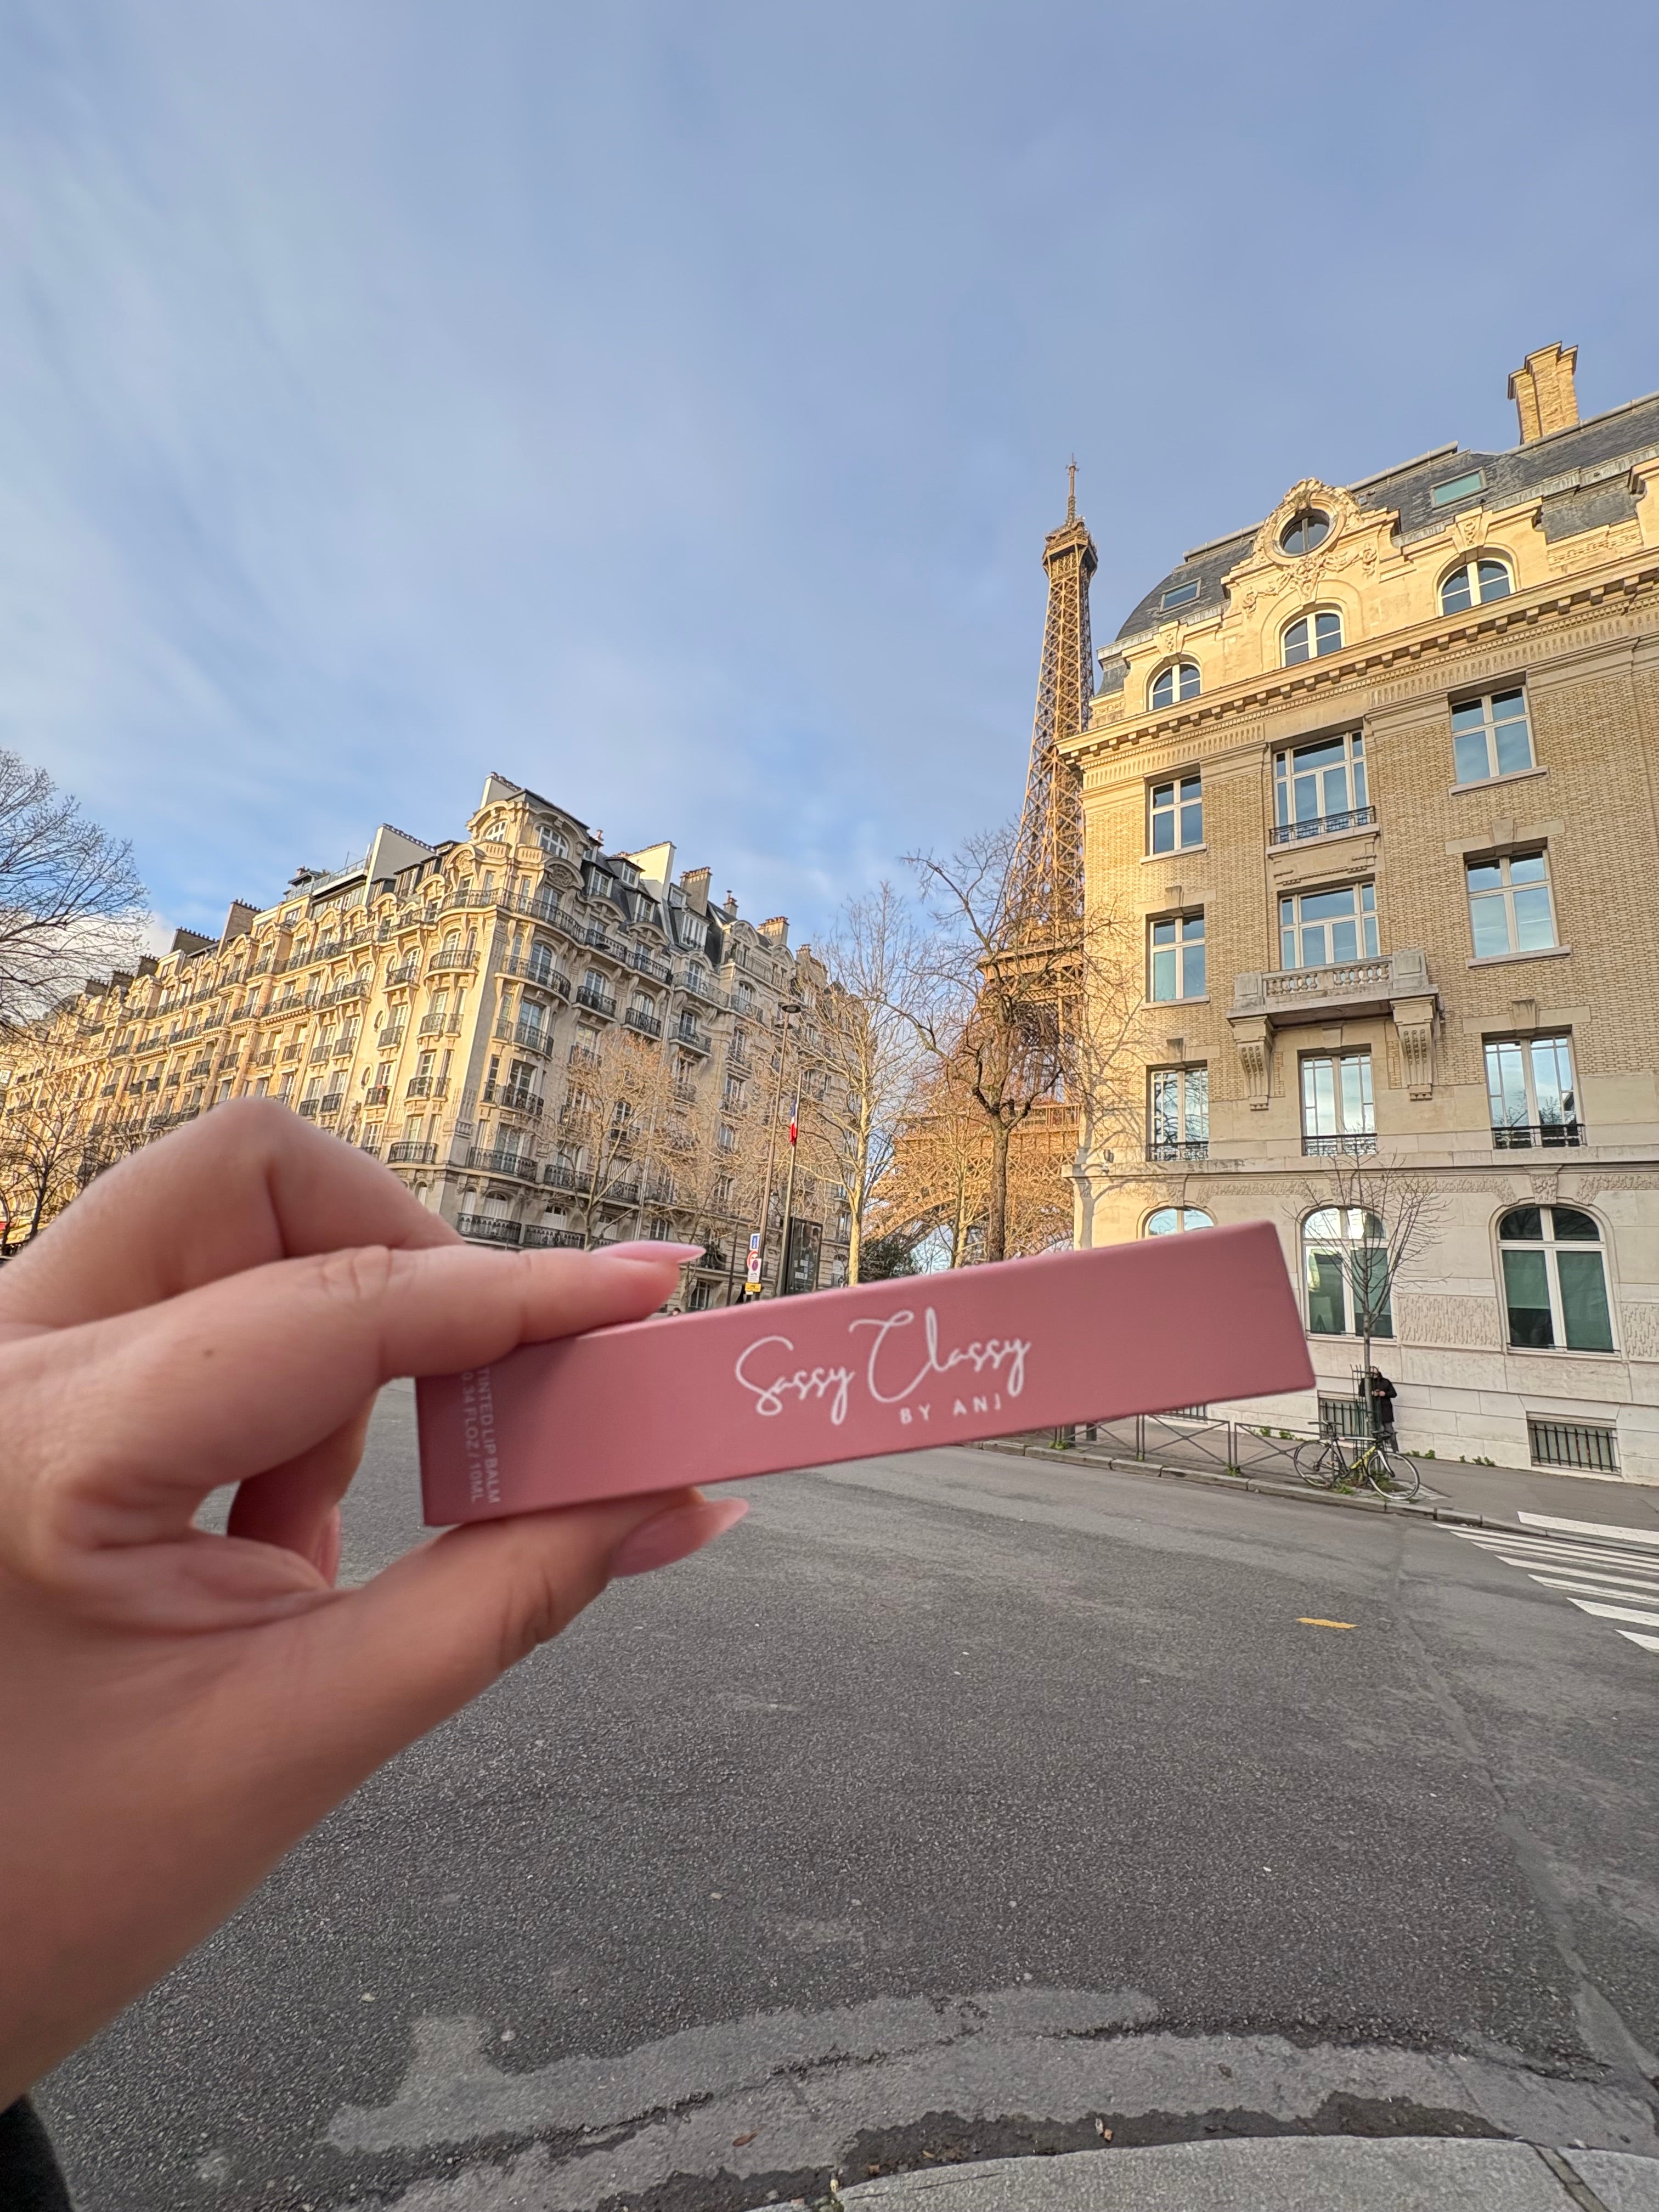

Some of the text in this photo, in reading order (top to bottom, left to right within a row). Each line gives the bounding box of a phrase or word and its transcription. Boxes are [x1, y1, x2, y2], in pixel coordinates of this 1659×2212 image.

[735, 1307, 1031, 1425] Sassy Classy
[478, 1369, 501, 1503] TINTED LIP BALM
[900, 1403, 931, 1424] BY
[468, 1463, 484, 1504] 10ML
